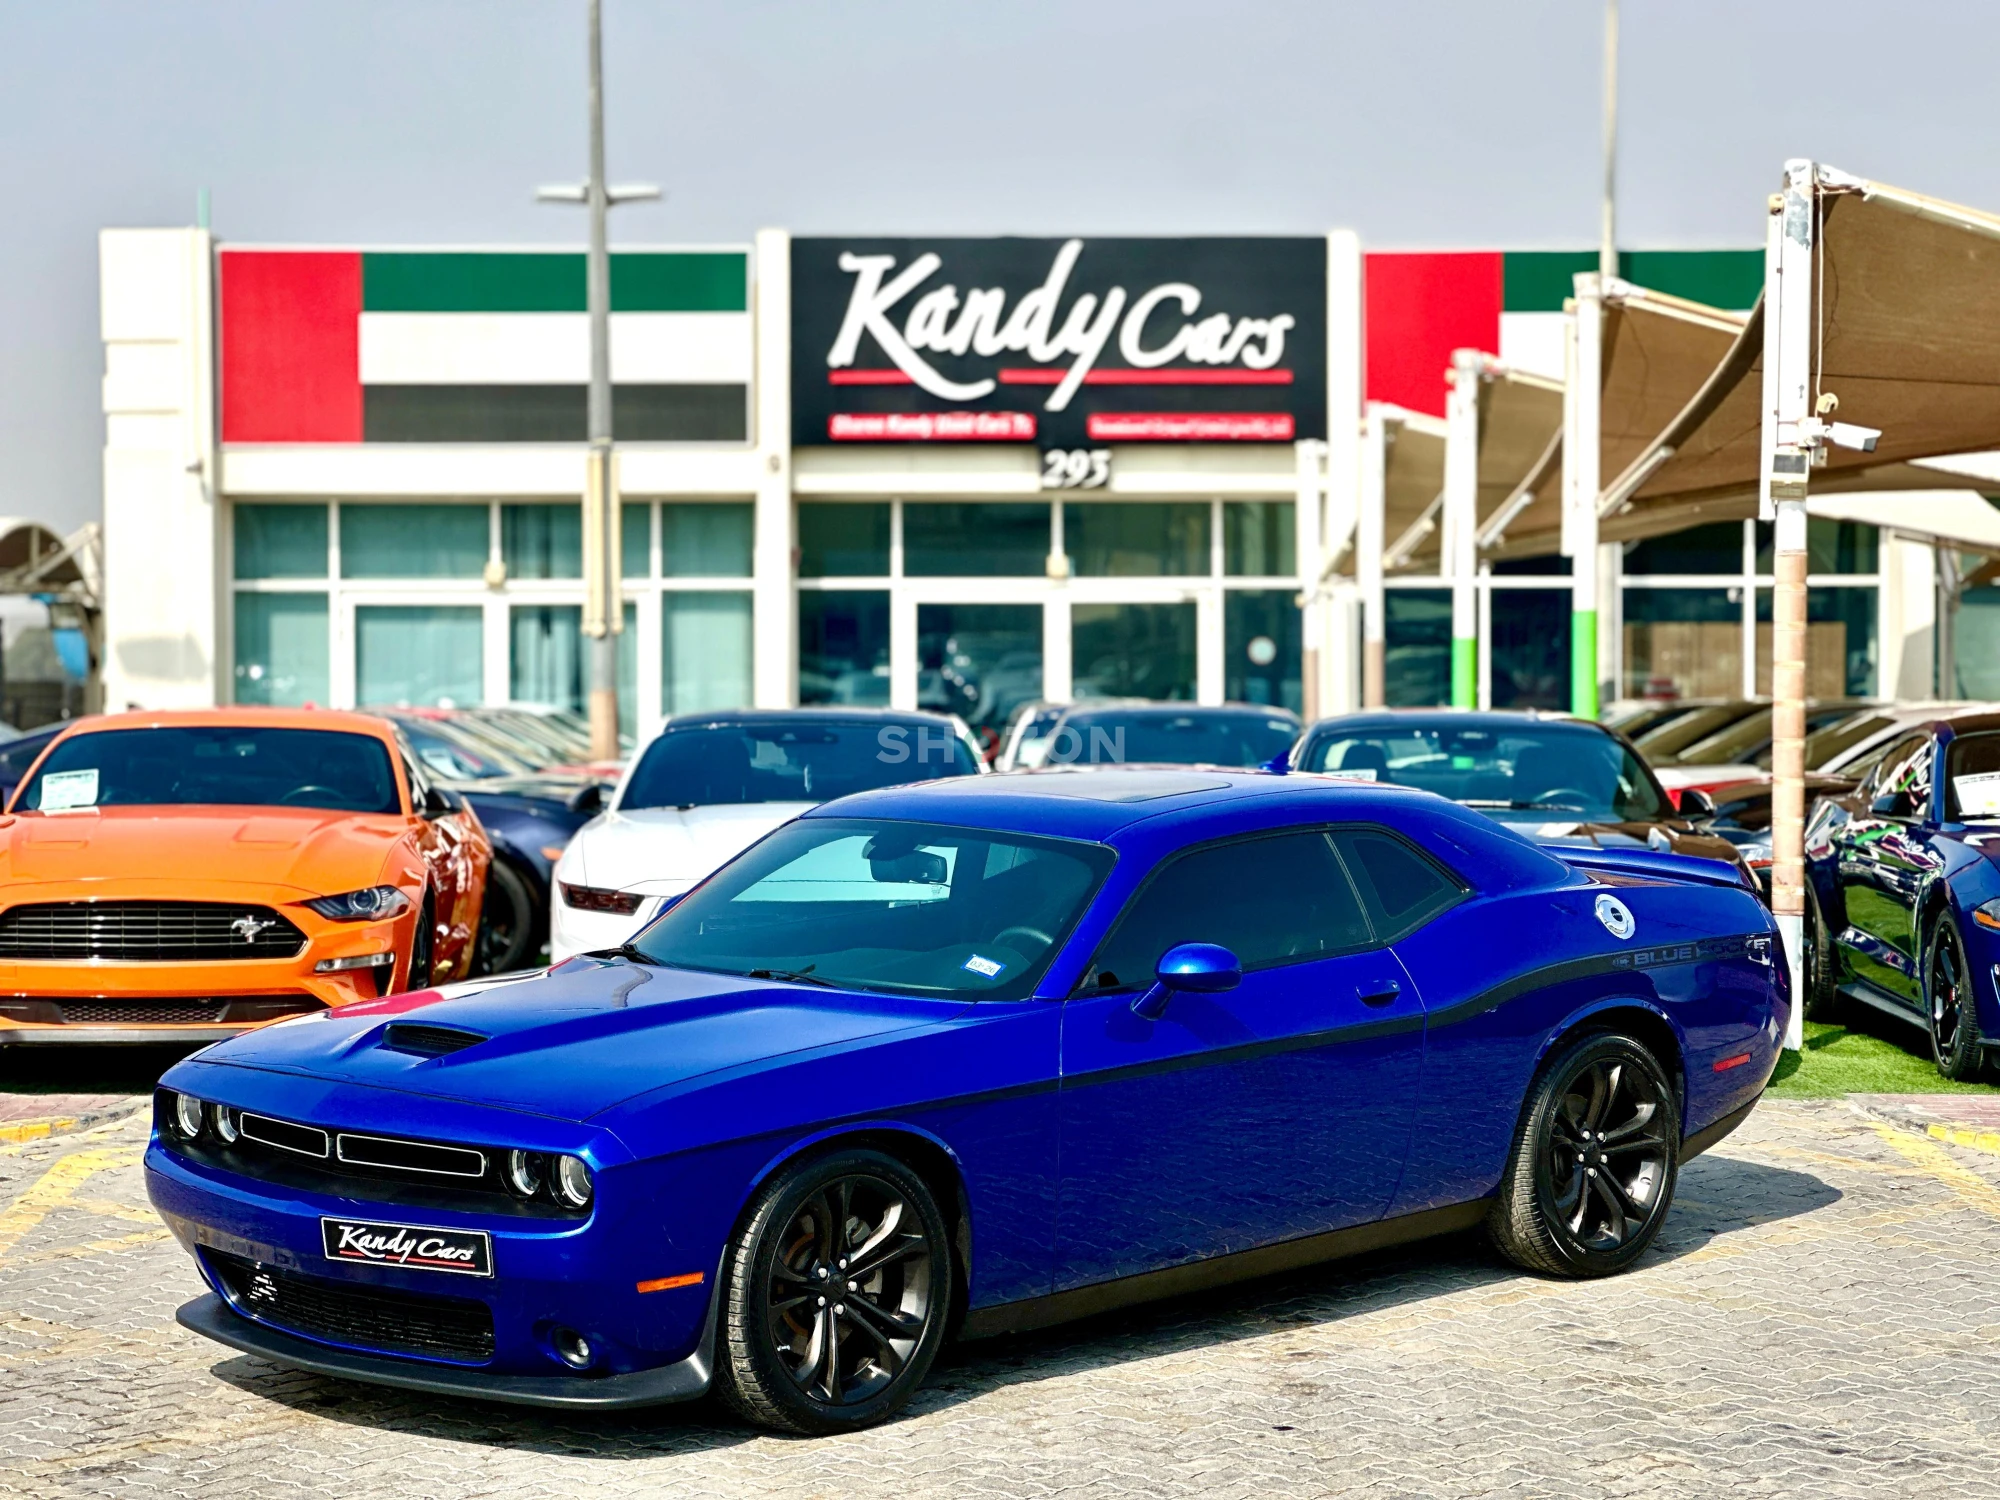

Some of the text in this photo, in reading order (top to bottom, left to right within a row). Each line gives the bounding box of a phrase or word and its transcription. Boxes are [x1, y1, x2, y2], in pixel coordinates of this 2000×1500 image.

[338, 225, 475, 263] Kandy Cars
[826, 239, 1295, 412] Kandy Cars
[1041, 448, 1112, 488] 295
[1634, 947, 1692, 965] BLUE
